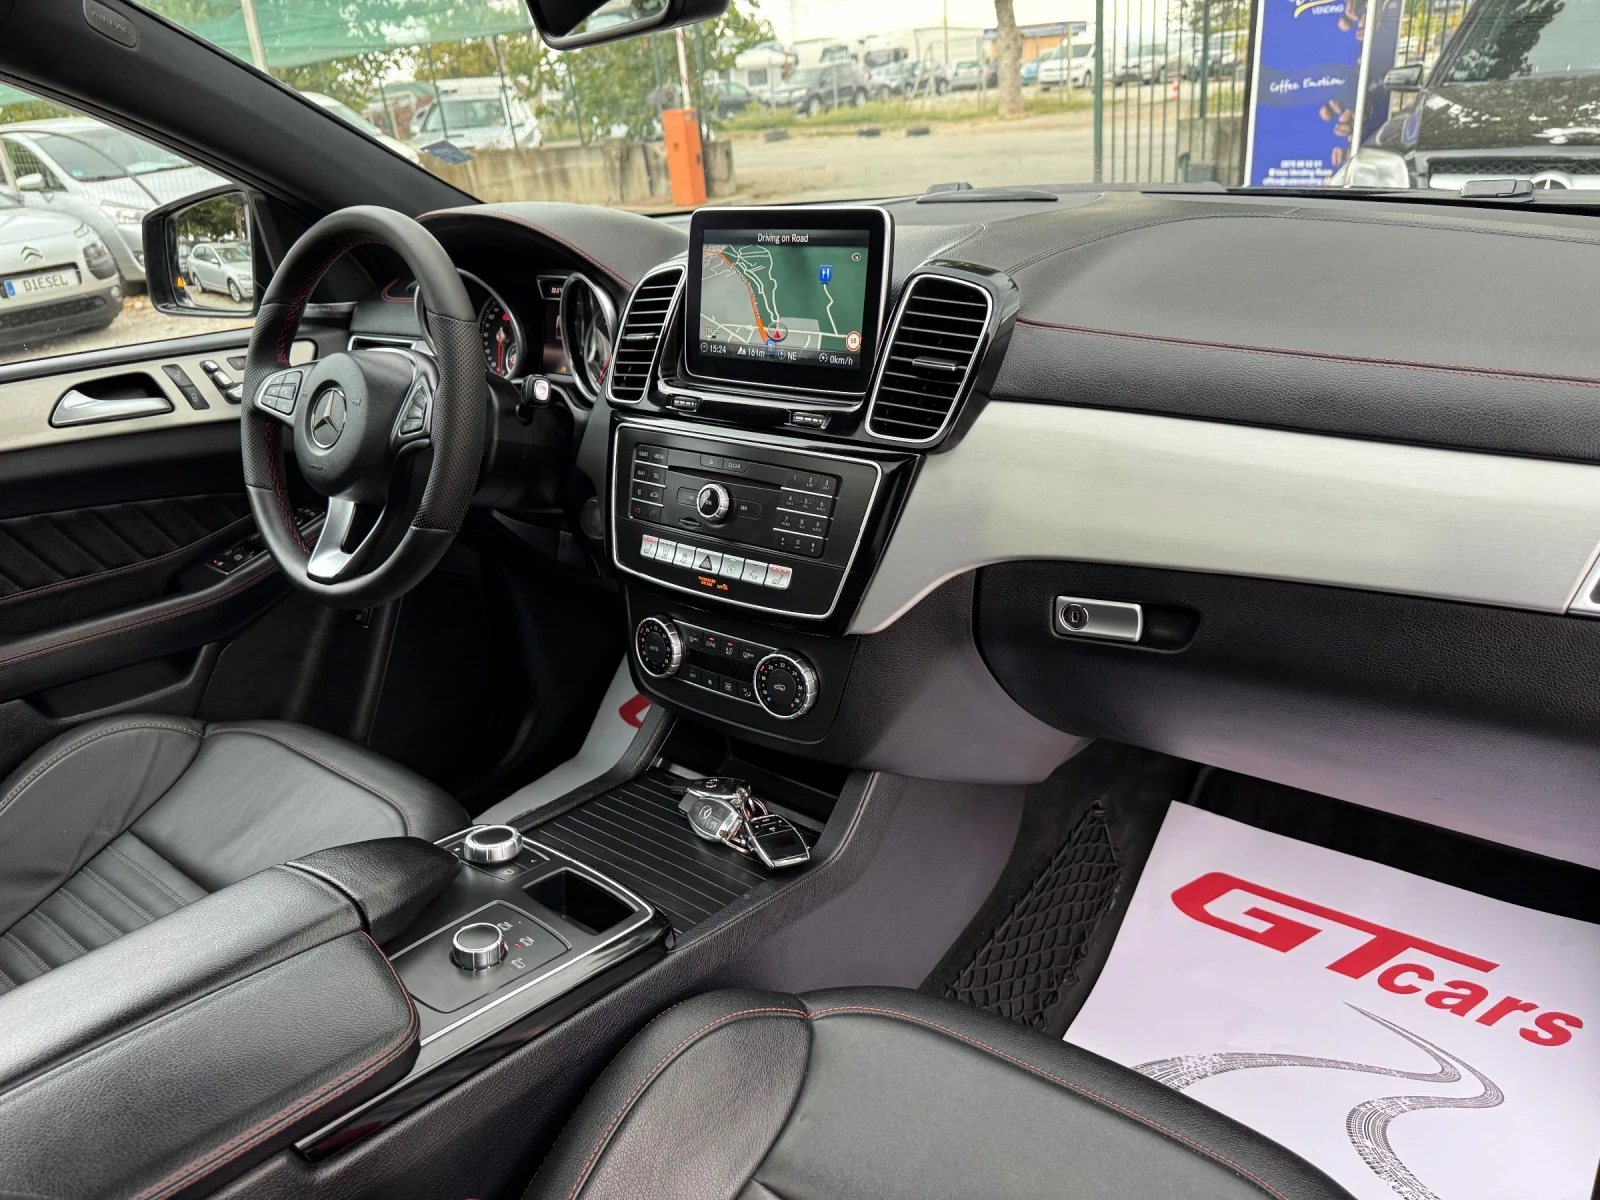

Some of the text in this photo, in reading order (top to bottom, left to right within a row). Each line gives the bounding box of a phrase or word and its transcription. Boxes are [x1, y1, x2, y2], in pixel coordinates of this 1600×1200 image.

[1270, 76, 1346, 94] Coffee Emotion
[757, 233, 780, 244] Driving
[792, 234, 809, 243] Road
[22, 274, 68, 292] DIESEL
[710, 344, 853, 366] 15:24 161m NE 0km/h
